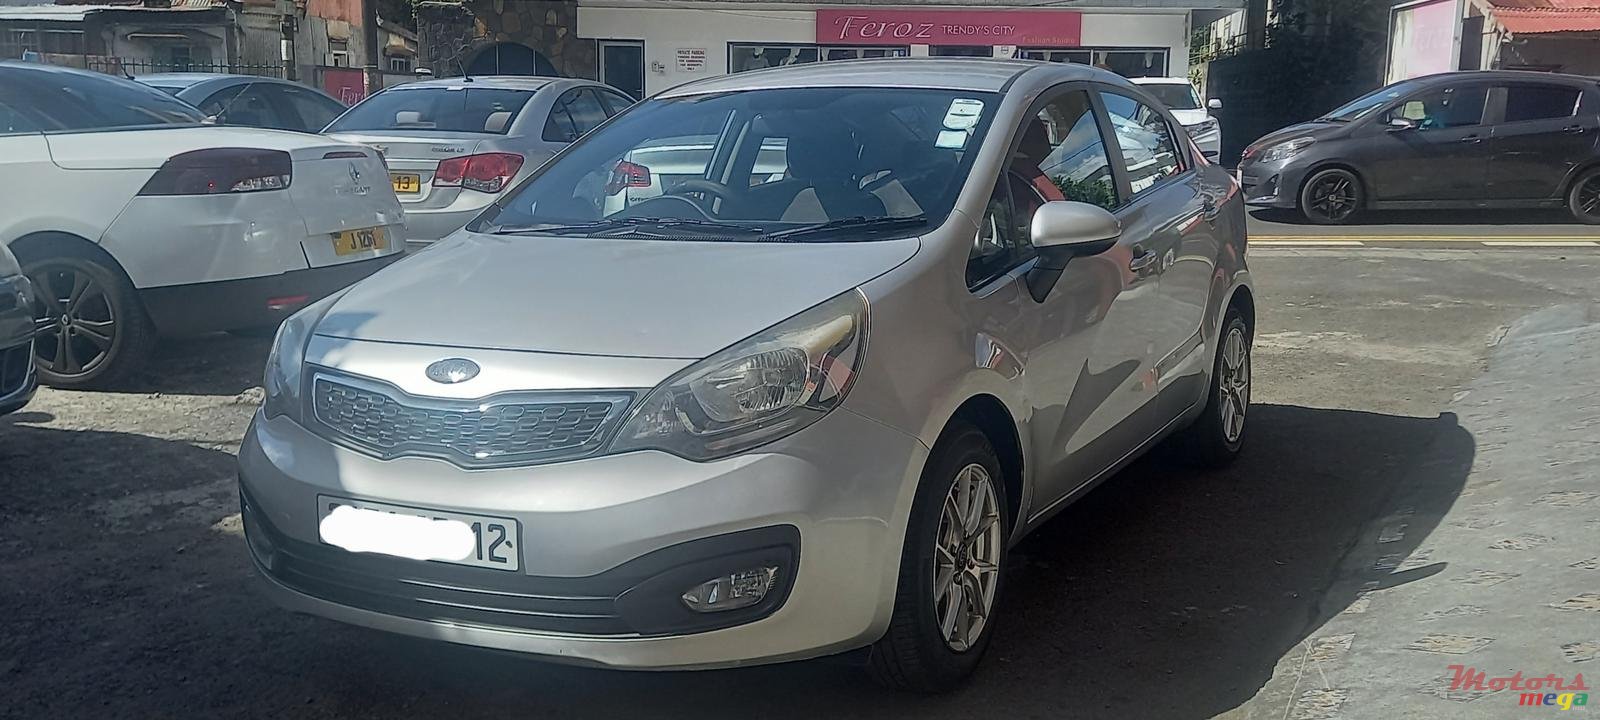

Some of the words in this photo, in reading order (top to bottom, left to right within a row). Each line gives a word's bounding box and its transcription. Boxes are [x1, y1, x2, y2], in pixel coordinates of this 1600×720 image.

[834, 14, 934, 40] Feroz
[942, 25, 990, 35] TRENDY'S
[992, 25, 1016, 35] CITY
[396, 175, 410, 190] 13
[351, 232, 357, 250] J
[471, 521, 507, 564] 12
